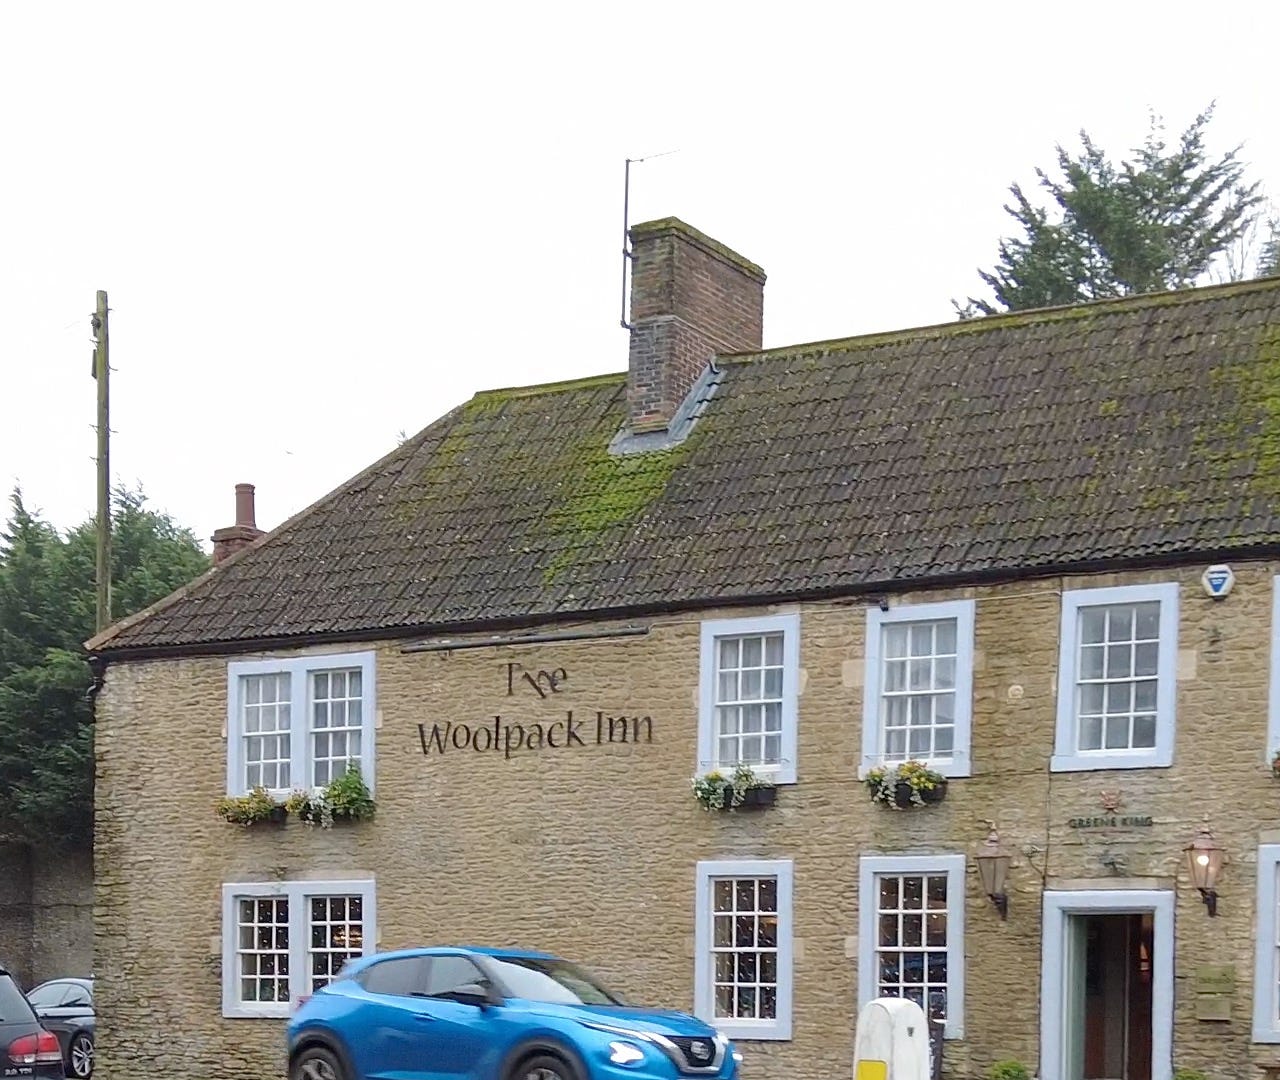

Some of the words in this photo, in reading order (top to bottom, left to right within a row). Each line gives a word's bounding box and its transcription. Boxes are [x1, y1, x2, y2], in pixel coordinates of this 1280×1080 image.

[417, 710, 587, 760] Woolpack
[595, 710, 653, 744] Inn
[1068, 816, 1117, 829] GREENE
[1120, 815, 1154, 828] KING
